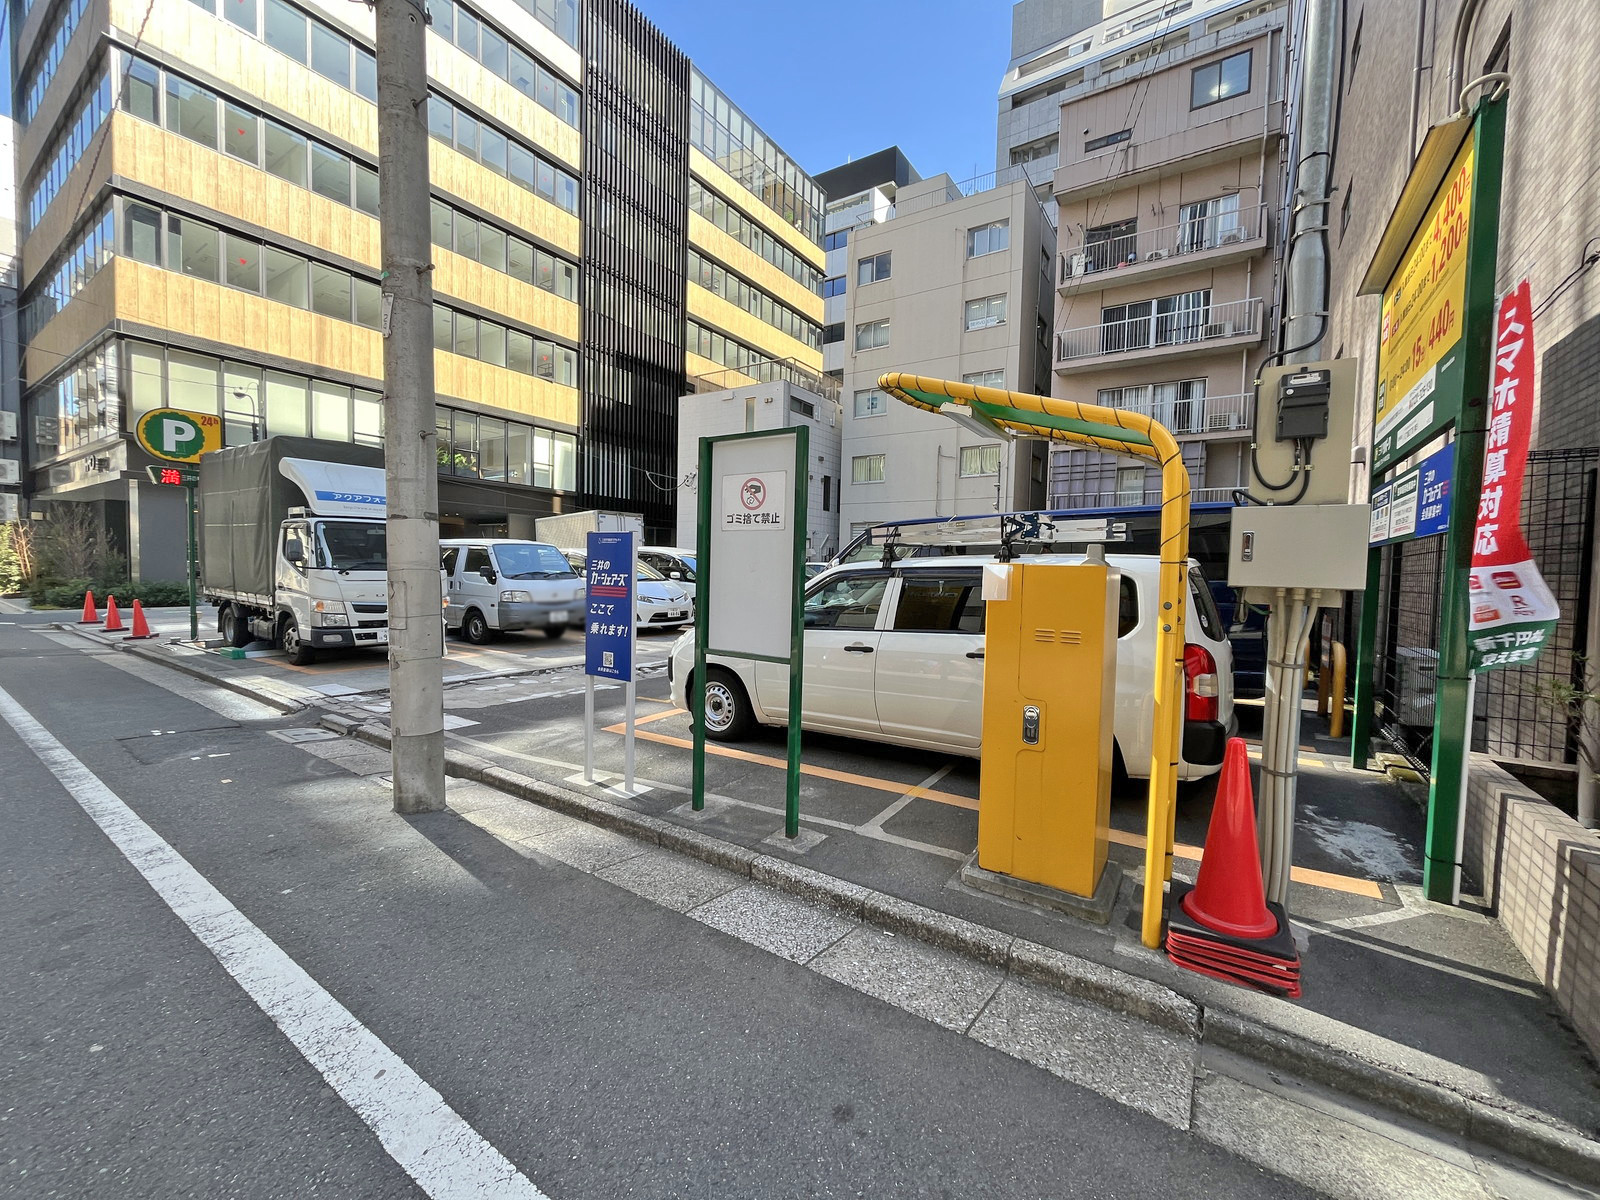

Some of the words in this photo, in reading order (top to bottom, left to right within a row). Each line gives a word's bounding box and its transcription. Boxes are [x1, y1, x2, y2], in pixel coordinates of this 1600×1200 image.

[162, 418, 196, 452] P
[200, 416, 219, 427] 24h
[1473, 307, 1525, 556] スマホ精算対応
[161, 469, 181, 485] 満
[726, 512, 780, 524] ゴミ捨て禁止
[591, 560, 610, 570] 三井の
[590, 603, 614, 616] ここで
[590, 622, 628, 637] 乗れます!
